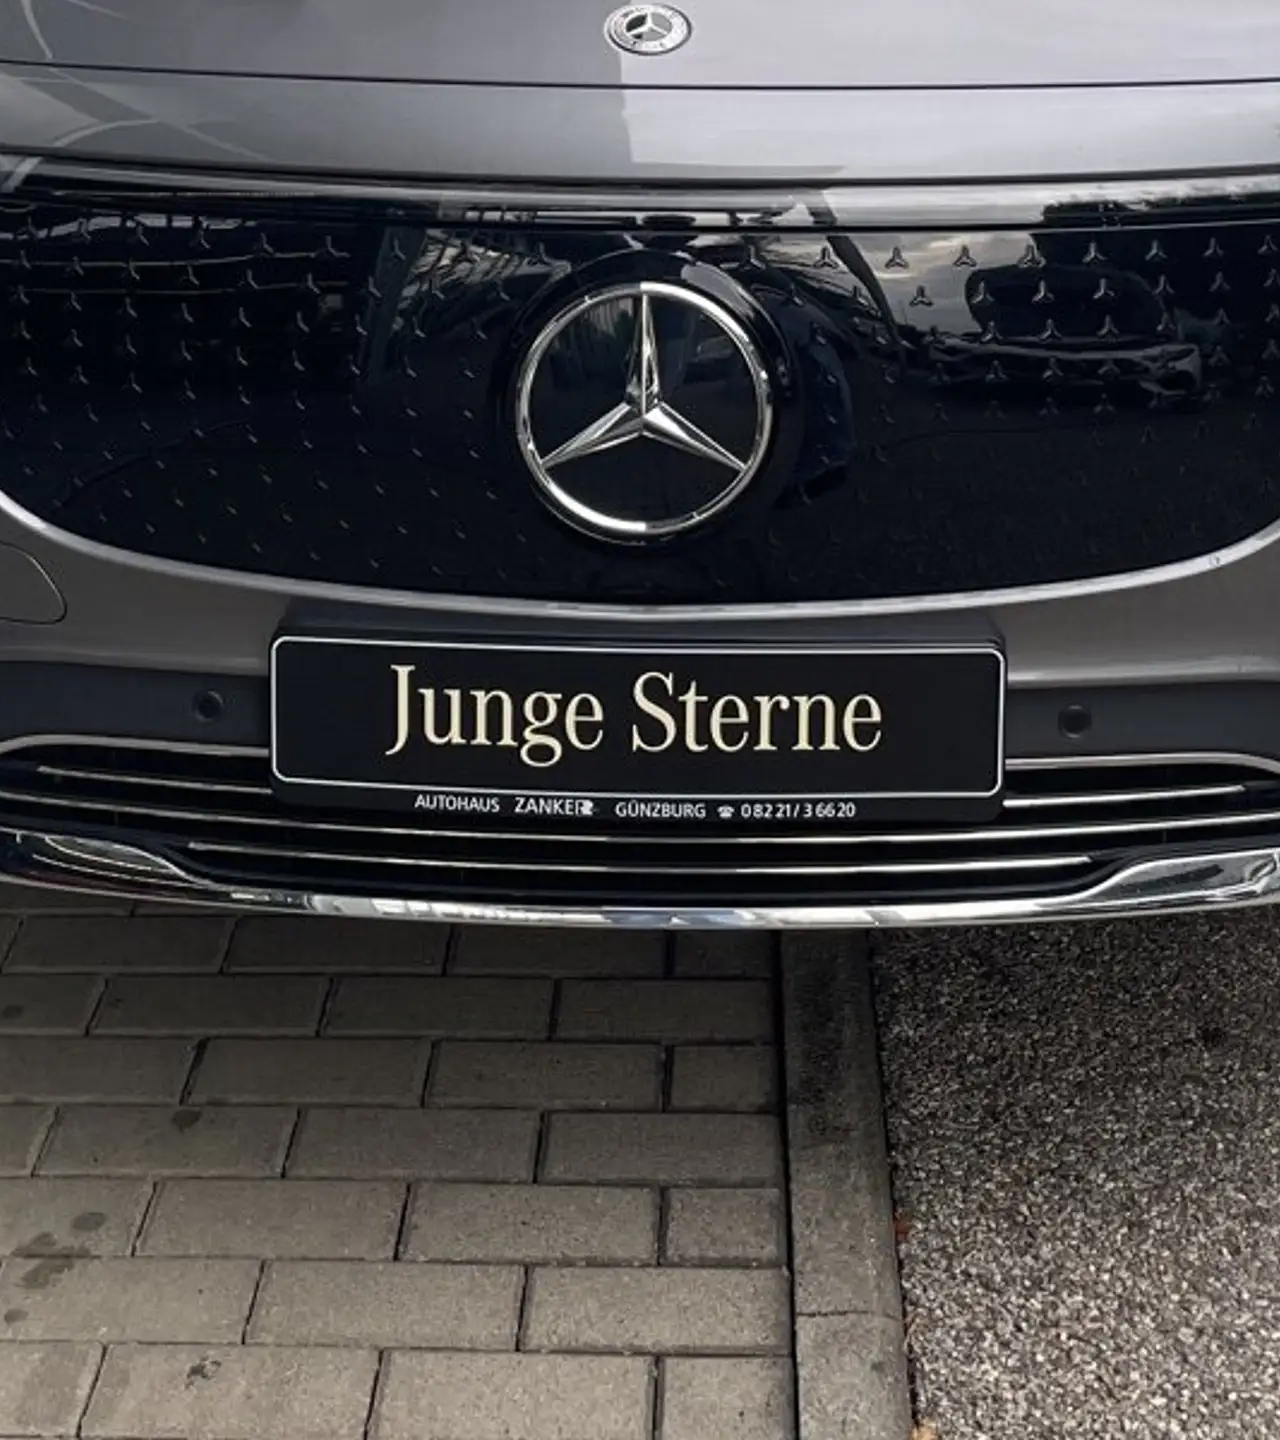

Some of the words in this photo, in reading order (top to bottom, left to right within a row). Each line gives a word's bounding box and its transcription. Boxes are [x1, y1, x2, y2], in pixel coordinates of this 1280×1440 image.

[384, 663, 605, 768] Junge
[631, 670, 884, 754] Sterne
[414, 793, 500, 813] AUTOHAUS
[615, 799, 707, 819] GÜNZBURG
